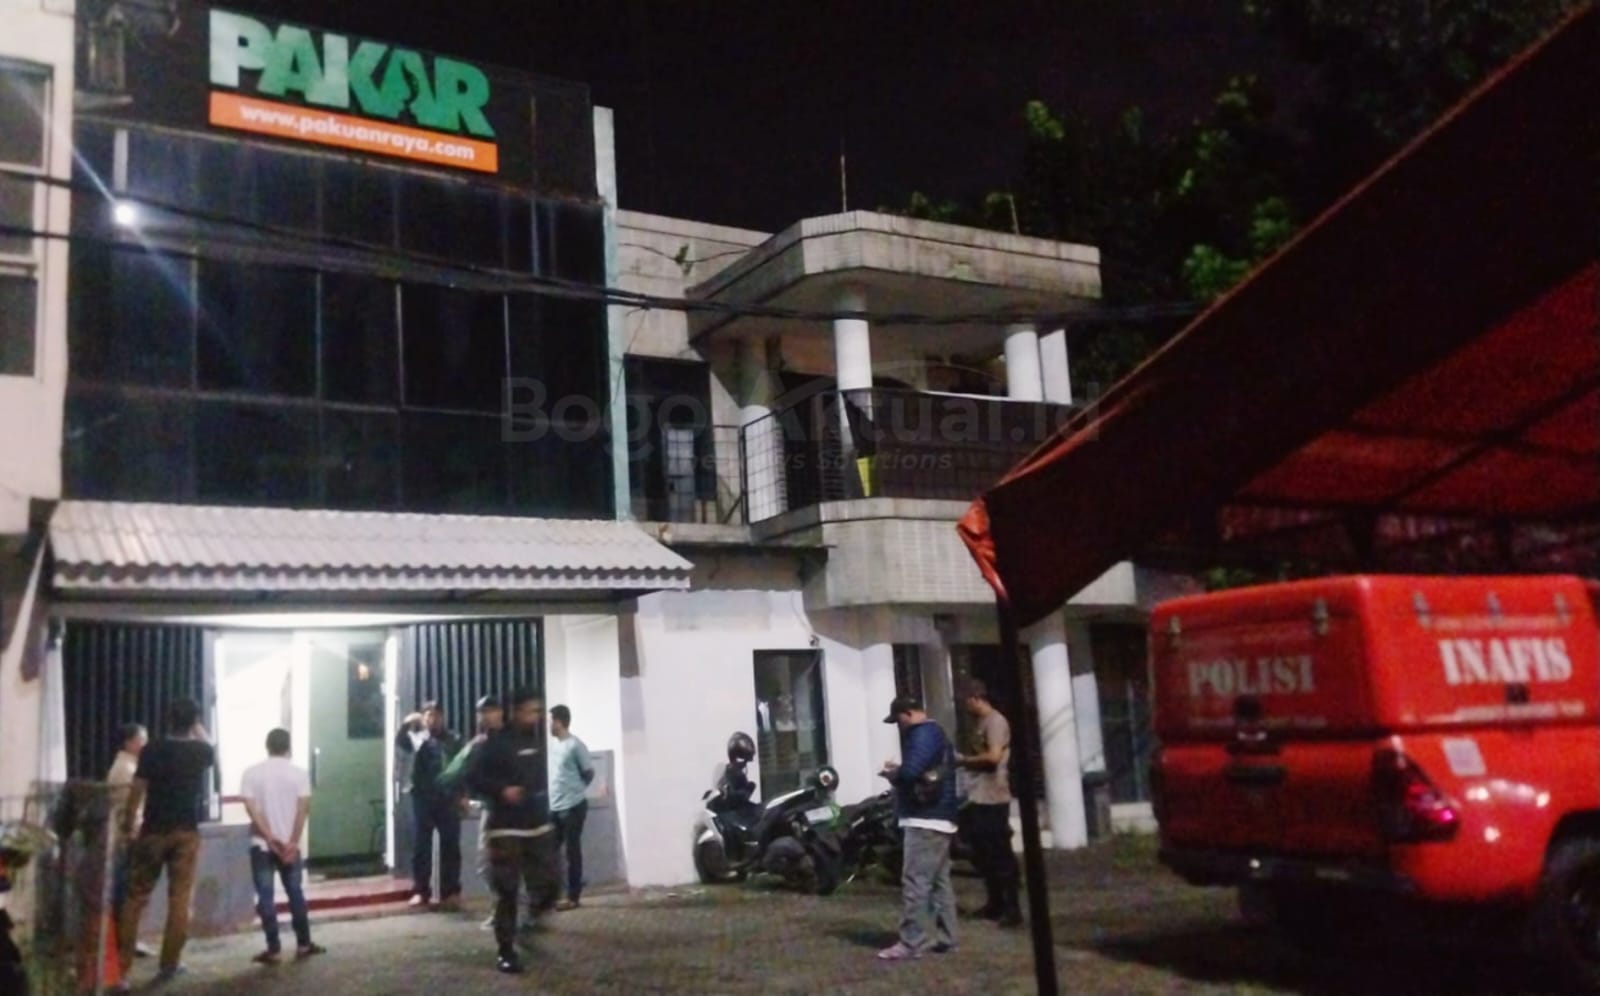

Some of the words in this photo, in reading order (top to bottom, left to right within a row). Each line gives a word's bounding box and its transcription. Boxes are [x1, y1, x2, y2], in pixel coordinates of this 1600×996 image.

[209, 9, 496, 137] PAKAR
[239, 105, 475, 161] www.pakuanraya.com
[1187, 654, 1316, 698] POLISI
[1437, 636, 1573, 686] INAFIS
